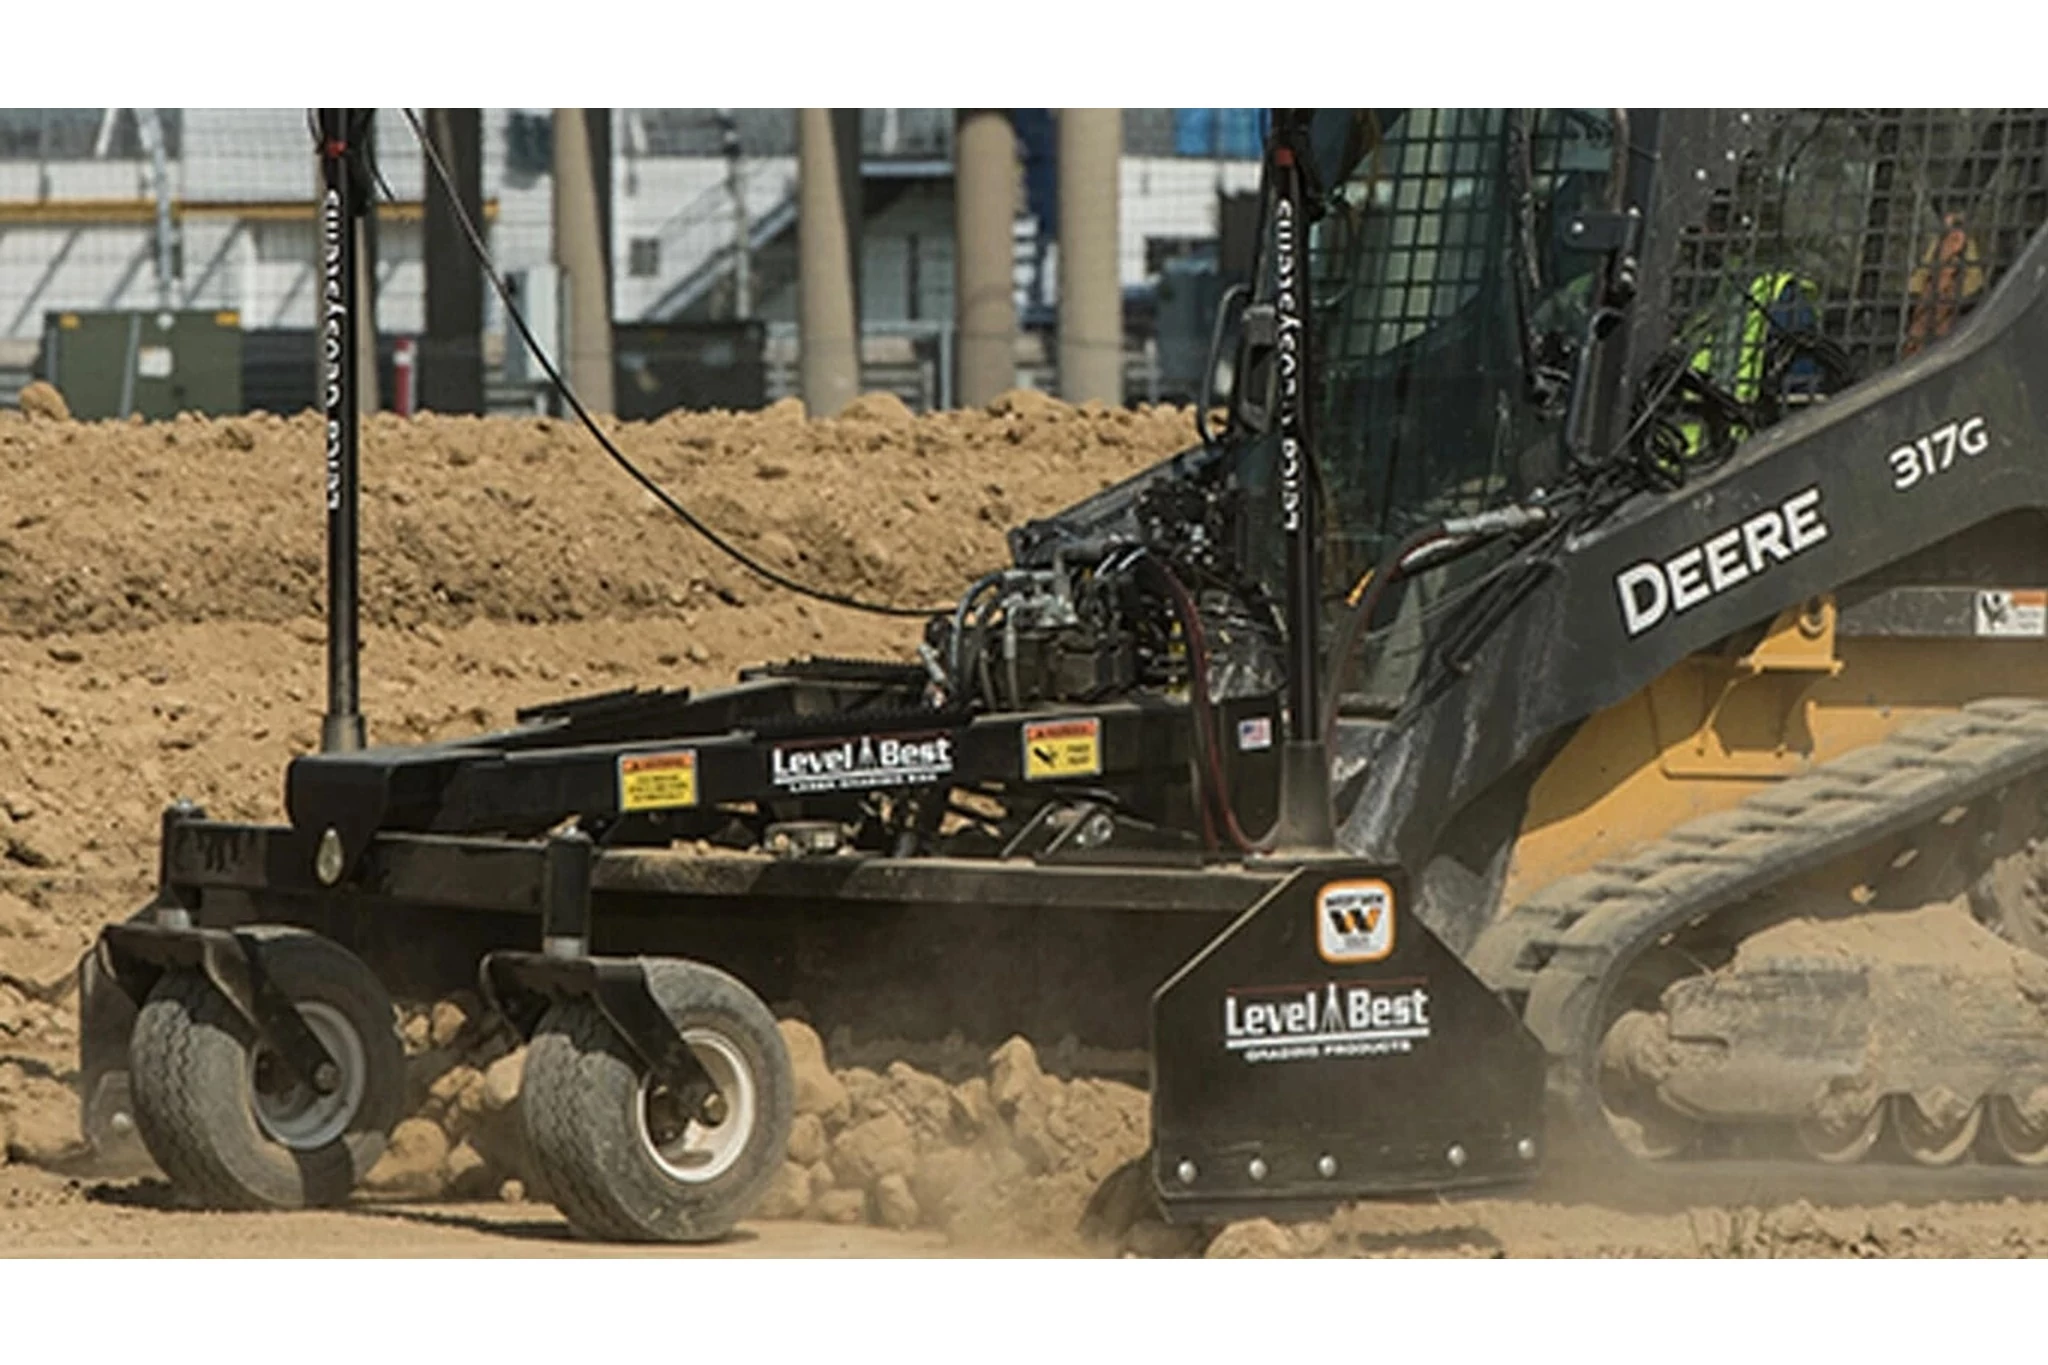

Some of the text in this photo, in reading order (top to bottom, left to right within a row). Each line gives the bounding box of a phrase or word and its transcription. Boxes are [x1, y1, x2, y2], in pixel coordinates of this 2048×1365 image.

[1888, 416, 1989, 490] 317G
[1616, 488, 1828, 636] DEERE
[773, 739, 951, 776] Level Best
[1225, 988, 1429, 1037] Level Best
